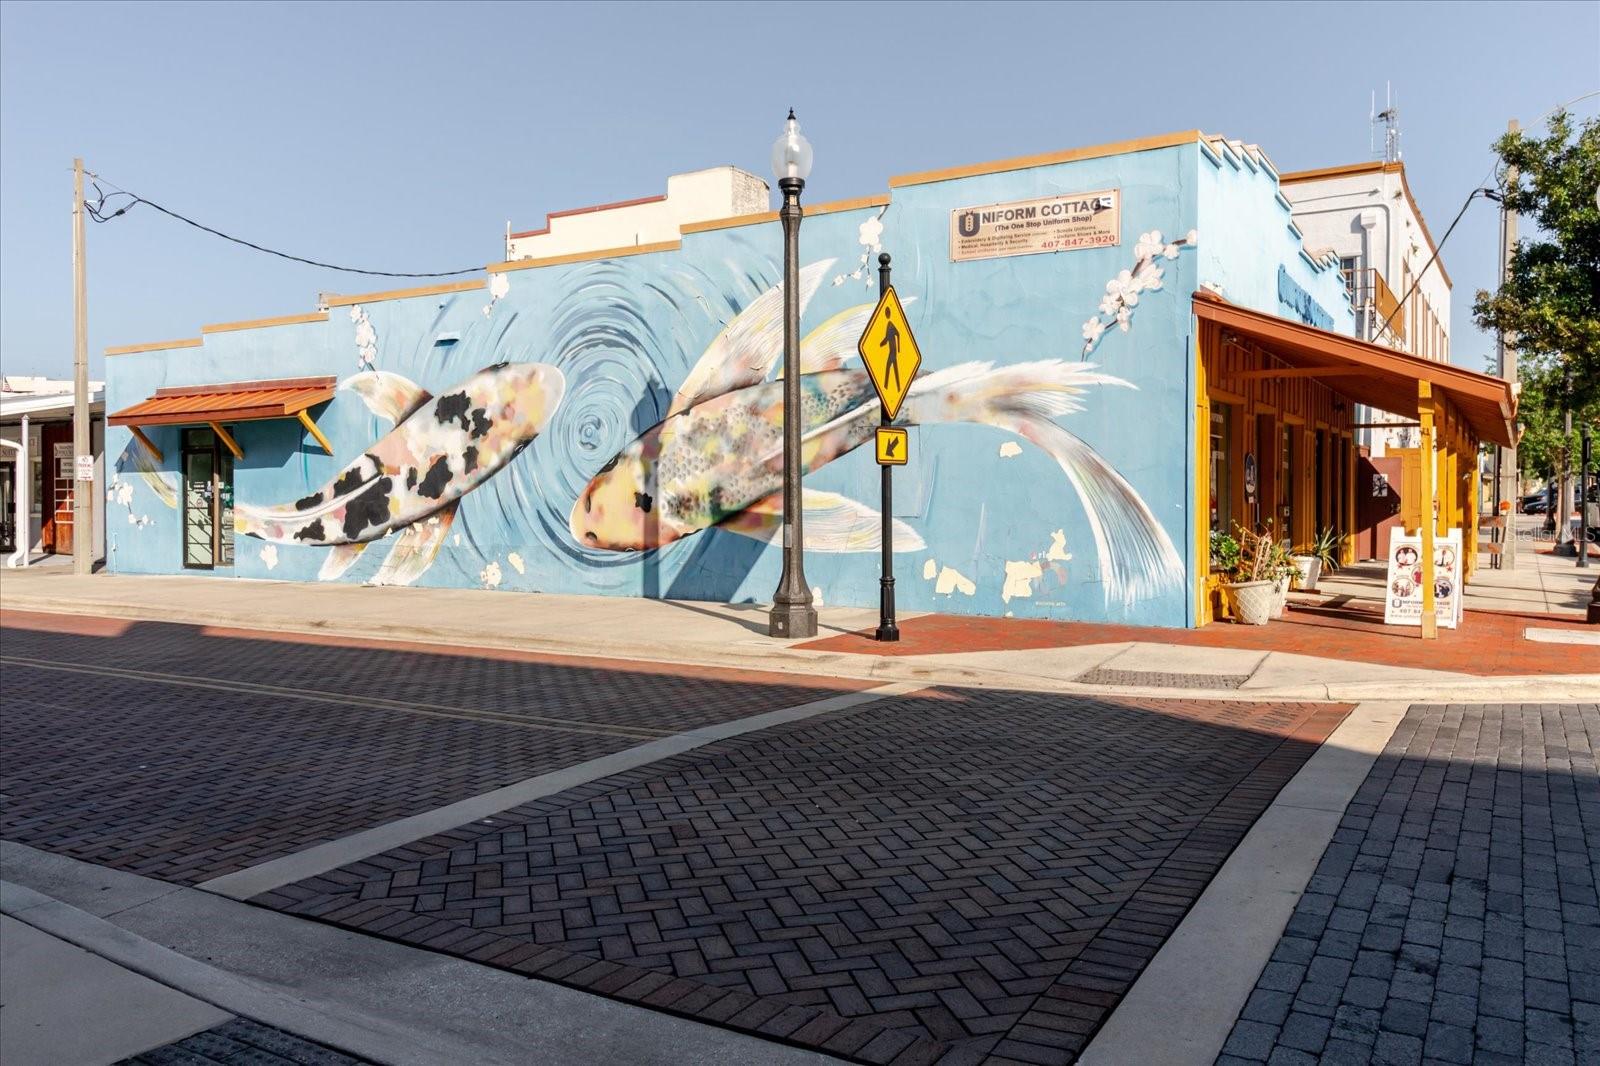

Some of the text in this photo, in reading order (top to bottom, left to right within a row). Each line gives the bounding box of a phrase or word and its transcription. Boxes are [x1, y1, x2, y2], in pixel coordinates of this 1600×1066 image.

[959, 198, 1100, 237] UNIFORM COTTAG
[995, 214, 1092, 232] (The One Stop Uniform Shop)
